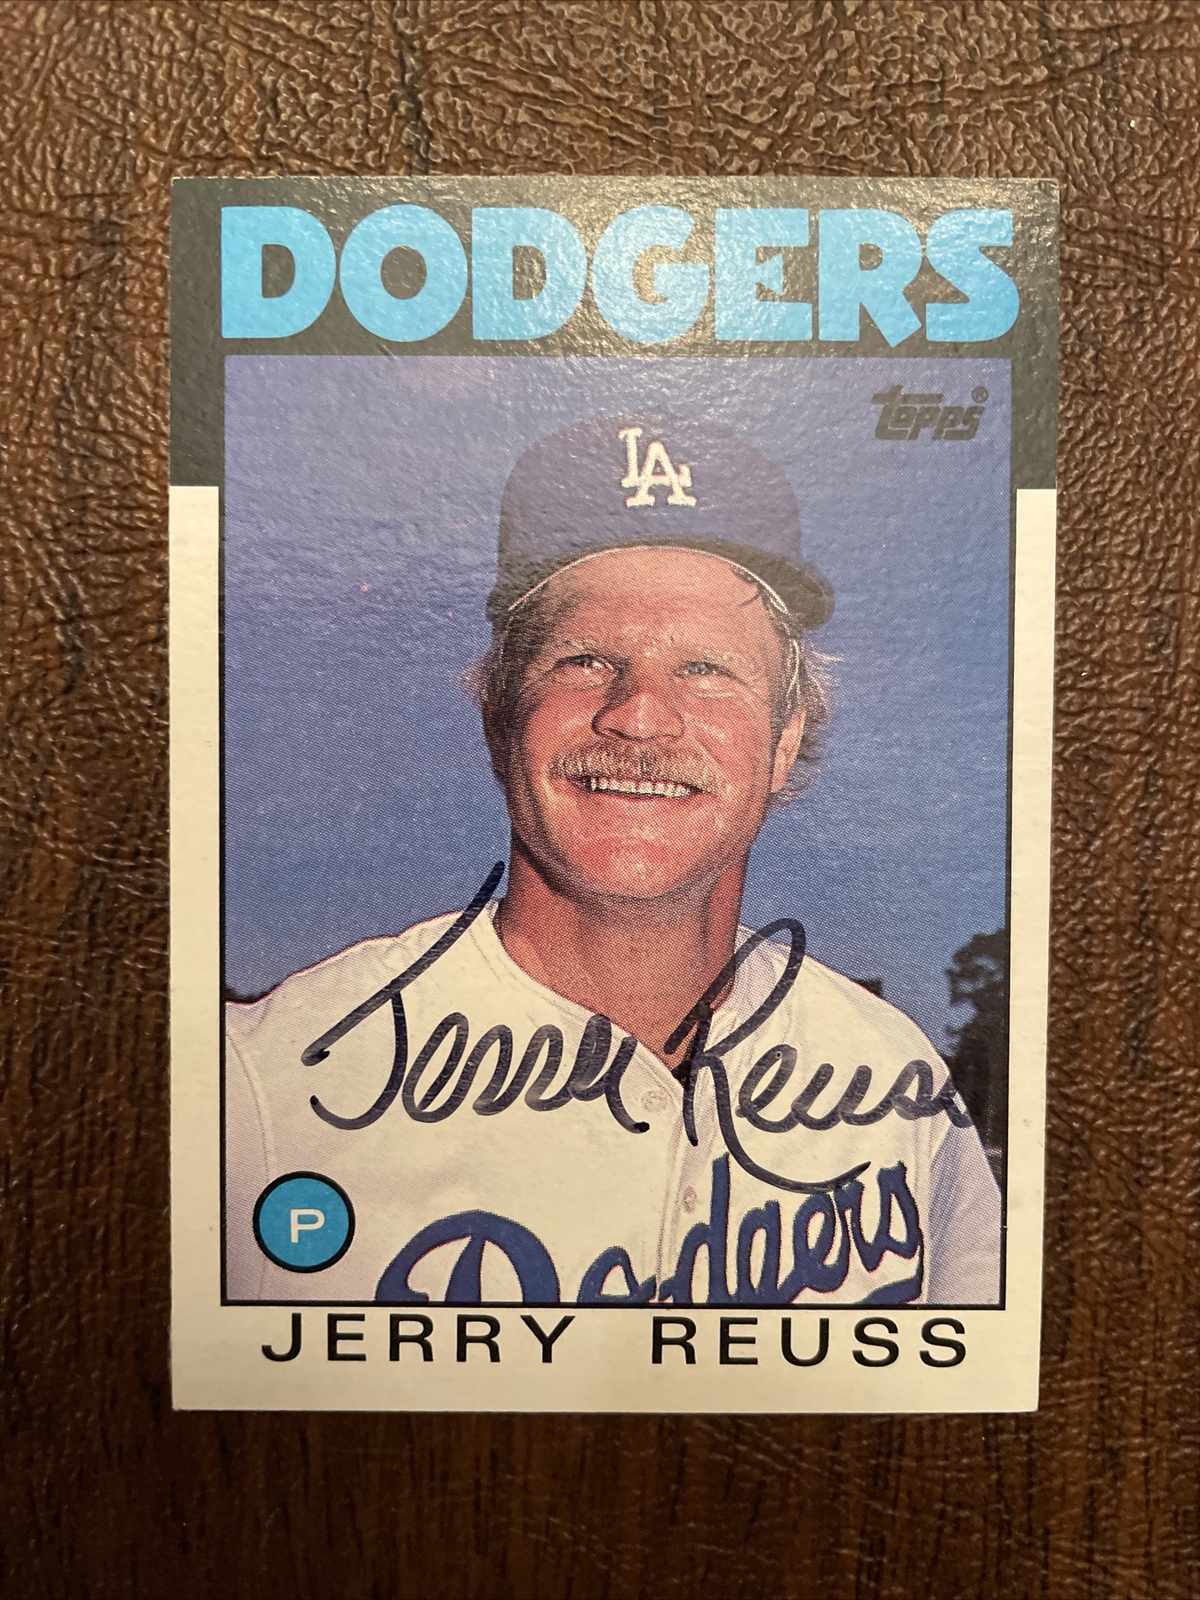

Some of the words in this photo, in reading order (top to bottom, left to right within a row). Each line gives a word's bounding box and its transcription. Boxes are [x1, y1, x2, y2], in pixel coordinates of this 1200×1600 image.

[221, 203, 1020, 350] DODGERS
[618, 426, 698, 508] LA
[290, 1208, 325, 1243] P
[261, 1312, 576, 1364] JERRY
[652, 1317, 967, 1367] REUSS
